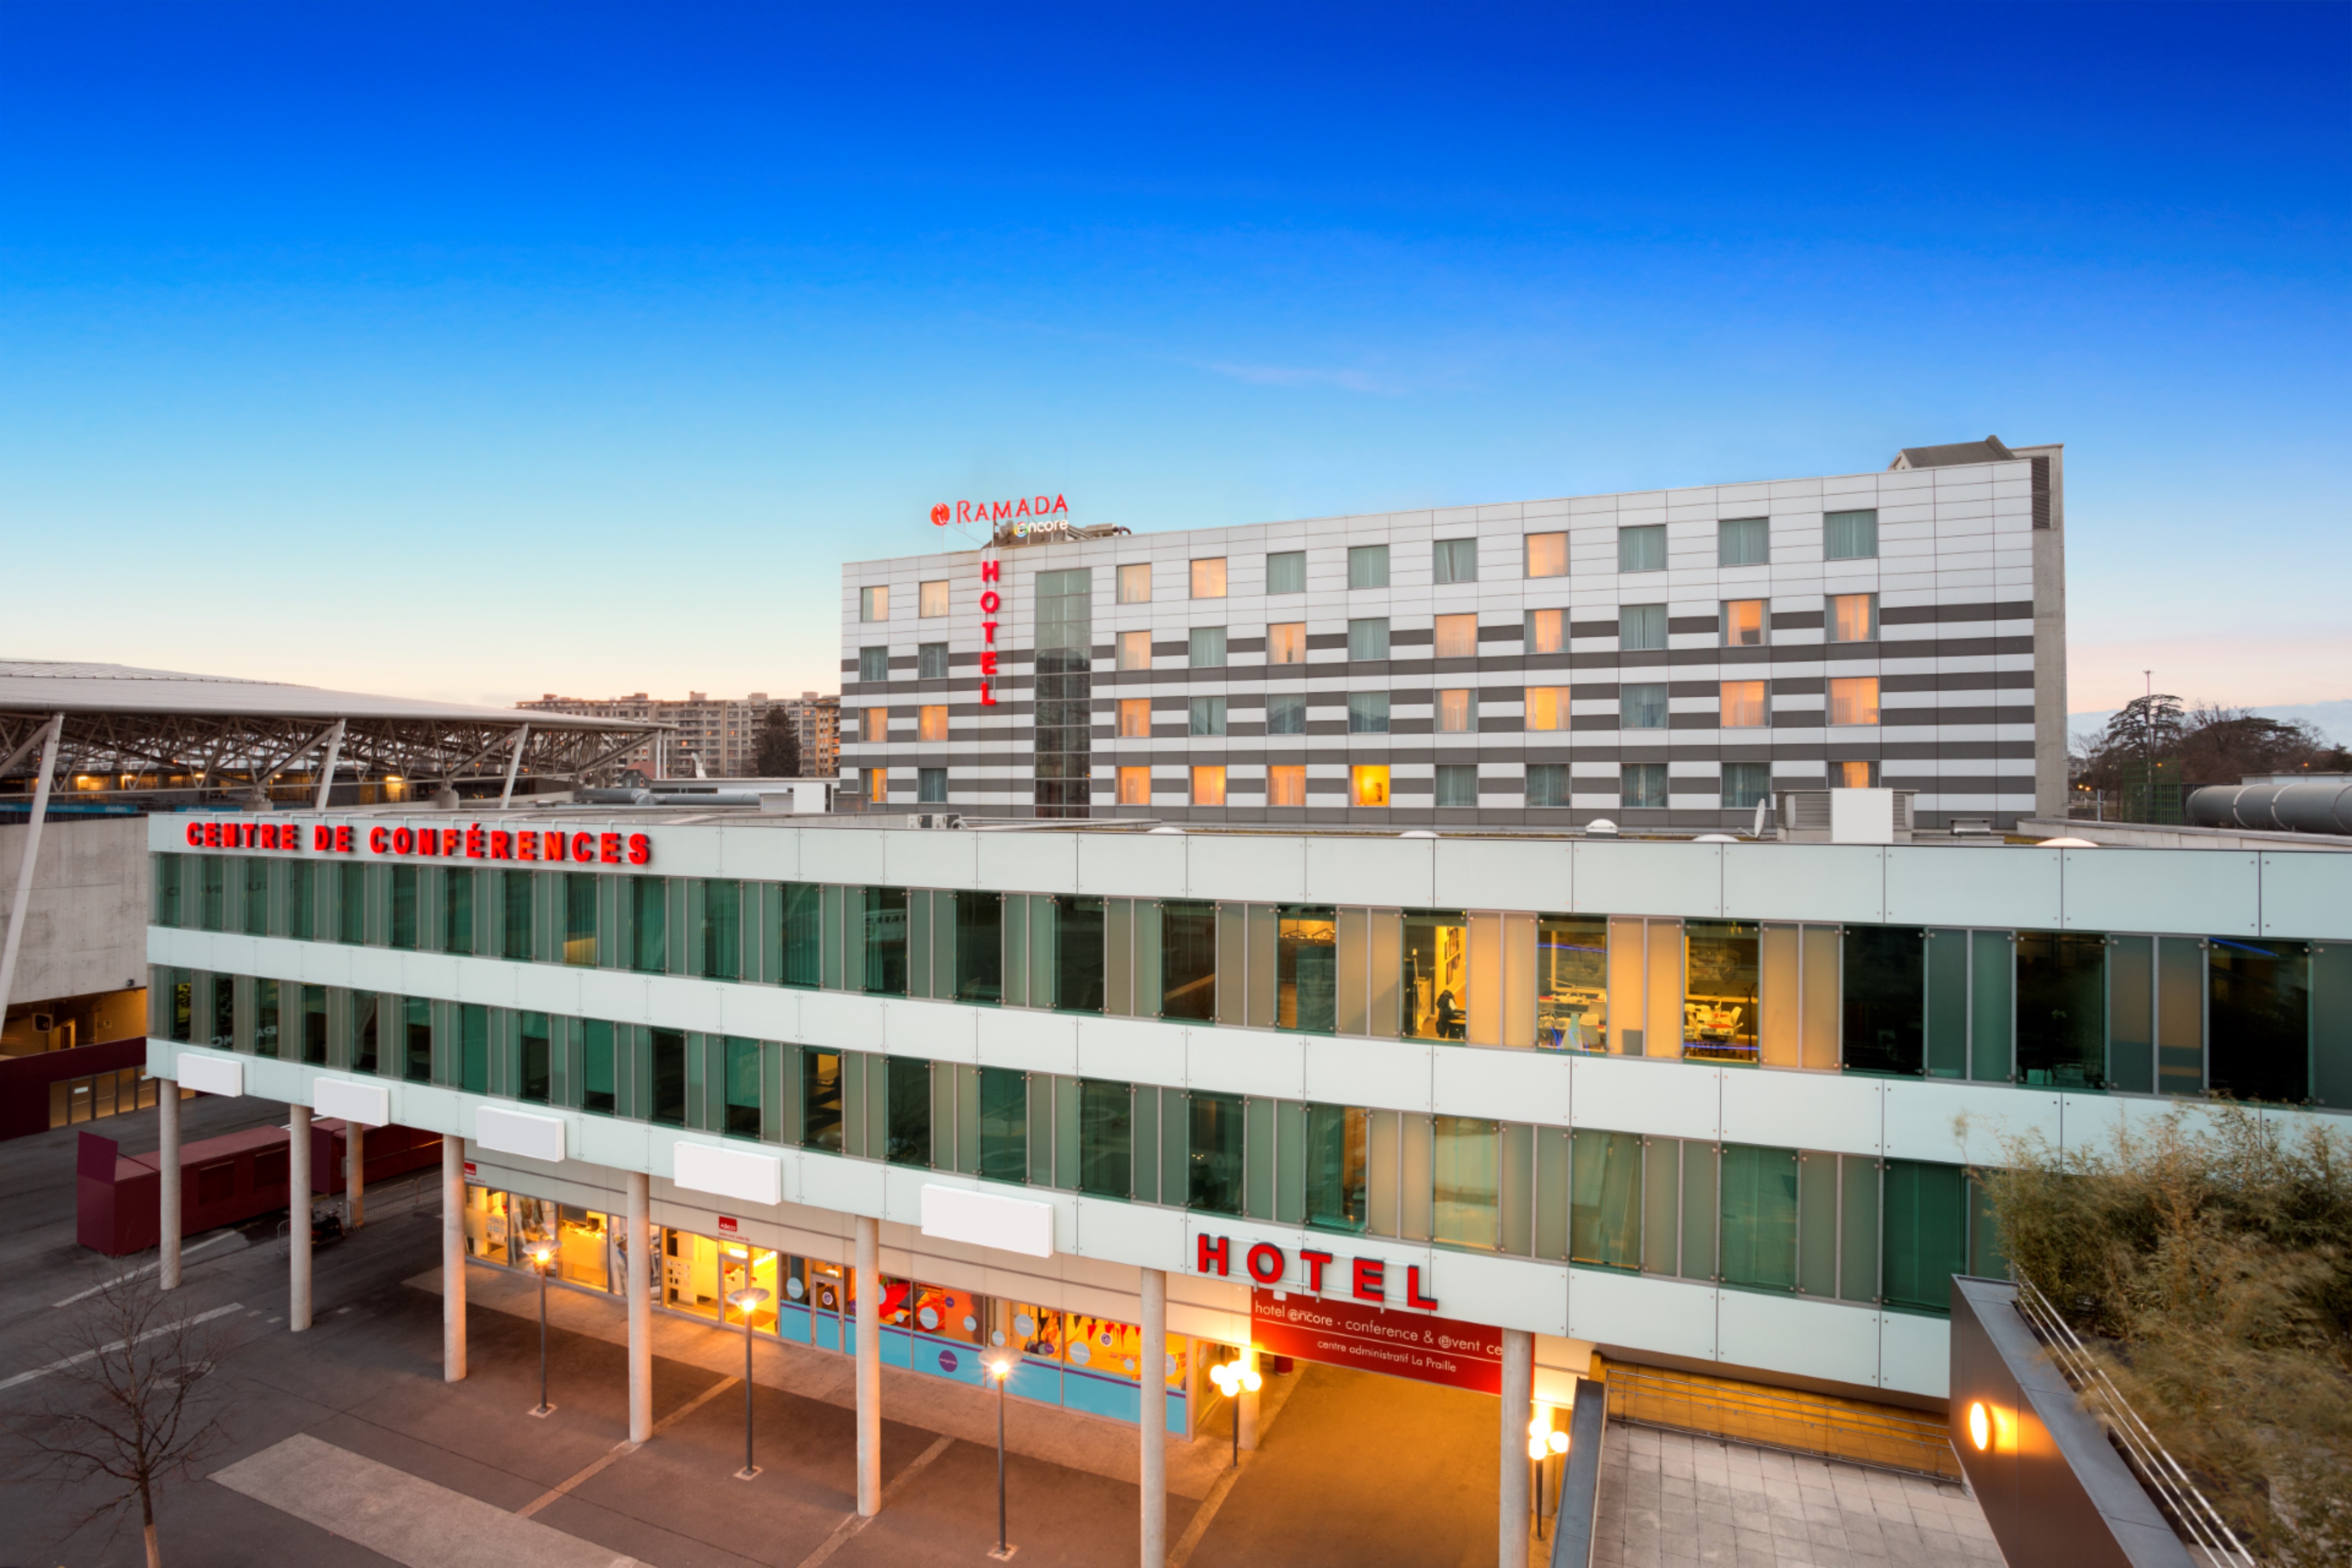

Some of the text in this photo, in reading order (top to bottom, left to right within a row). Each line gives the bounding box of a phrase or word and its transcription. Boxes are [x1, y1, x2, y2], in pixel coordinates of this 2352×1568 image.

[1014, 519, 1068, 537] encore
[979, 559, 1000, 706] HOTEL
[186, 822, 651, 866] CENTRE DE CONFÉRENCES
[1198, 1233, 1438, 1311] HOTEL
[1255, 1300, 1285, 1317] hotel
[1346, 1320, 1418, 1341] conference
[1423, 1330, 1434, 1344] &
[1317, 1340, 1457, 1372] centre administratif La Praille
